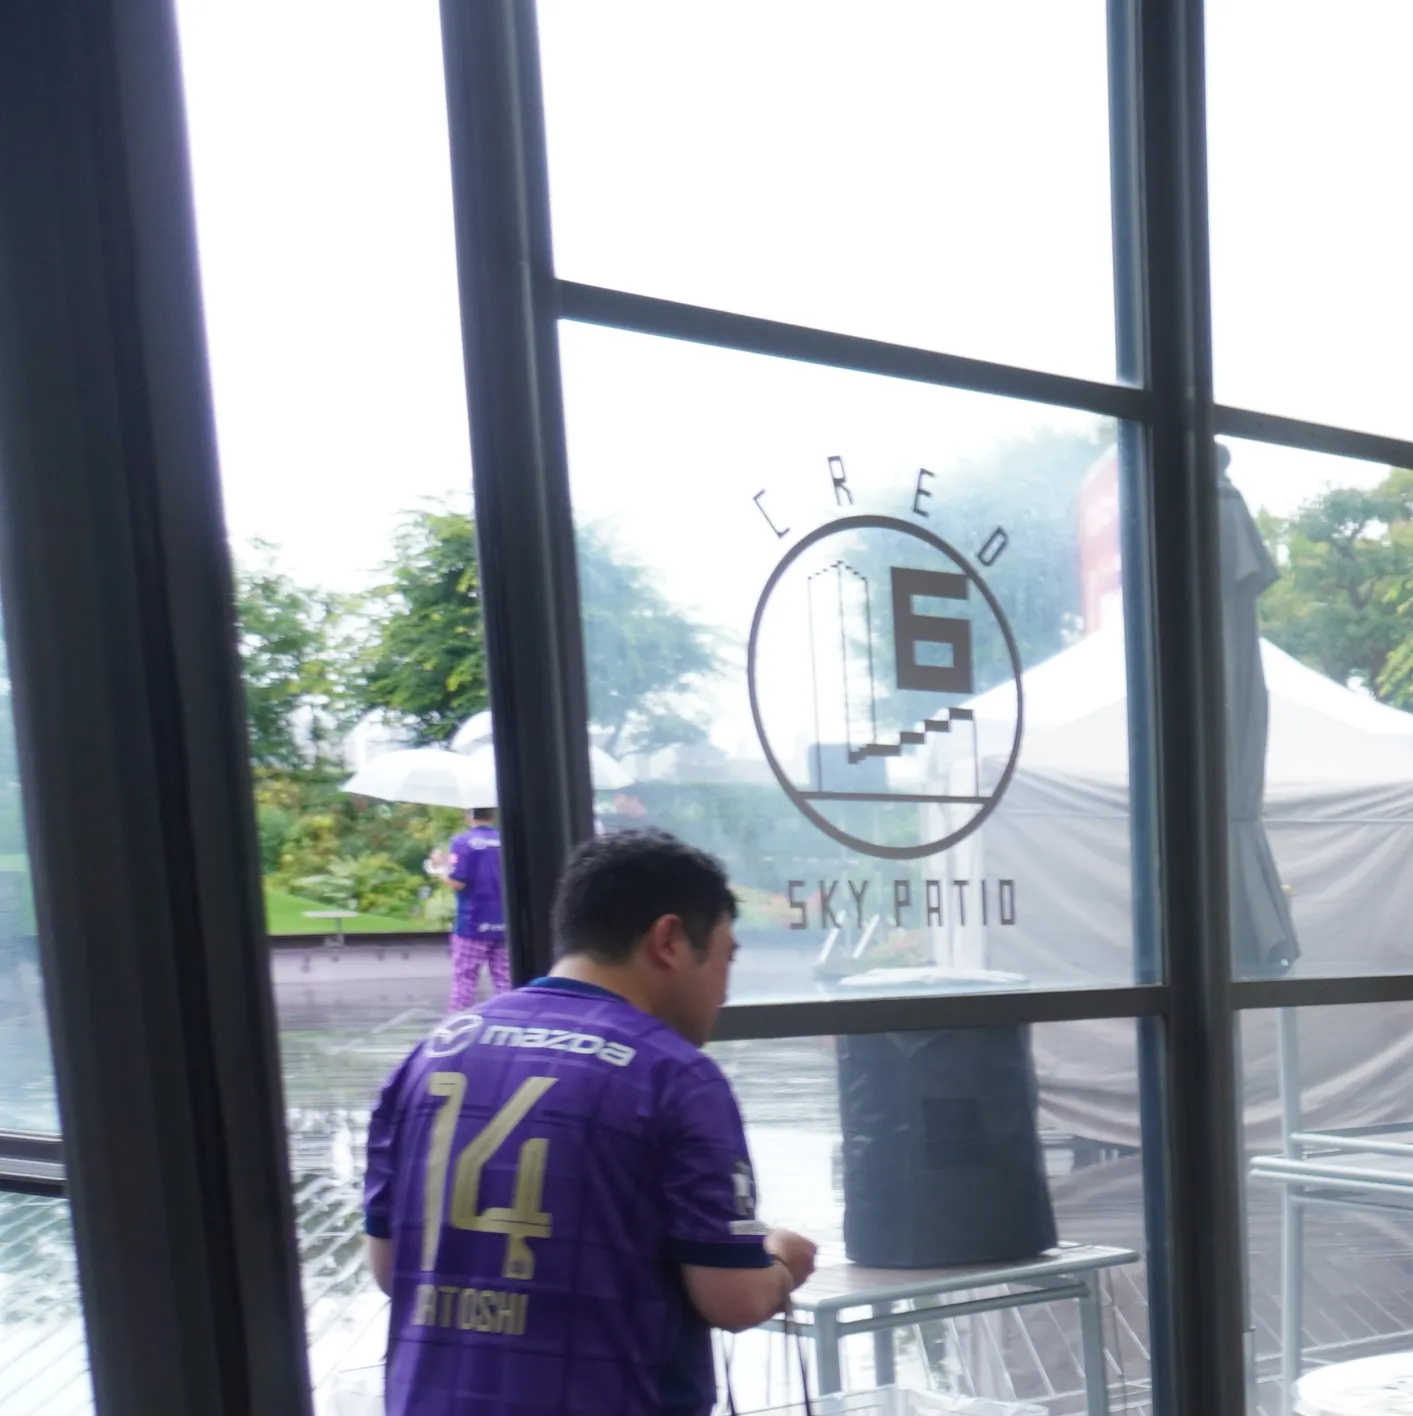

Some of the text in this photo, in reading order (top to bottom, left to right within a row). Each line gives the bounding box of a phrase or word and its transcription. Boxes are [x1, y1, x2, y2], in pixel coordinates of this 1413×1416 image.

[890, 566, 974, 695] 6
[788, 879, 1016, 931] SKY PATIO
[479, 1024, 638, 1068] mazda
[420, 1071, 560, 1281] 14
